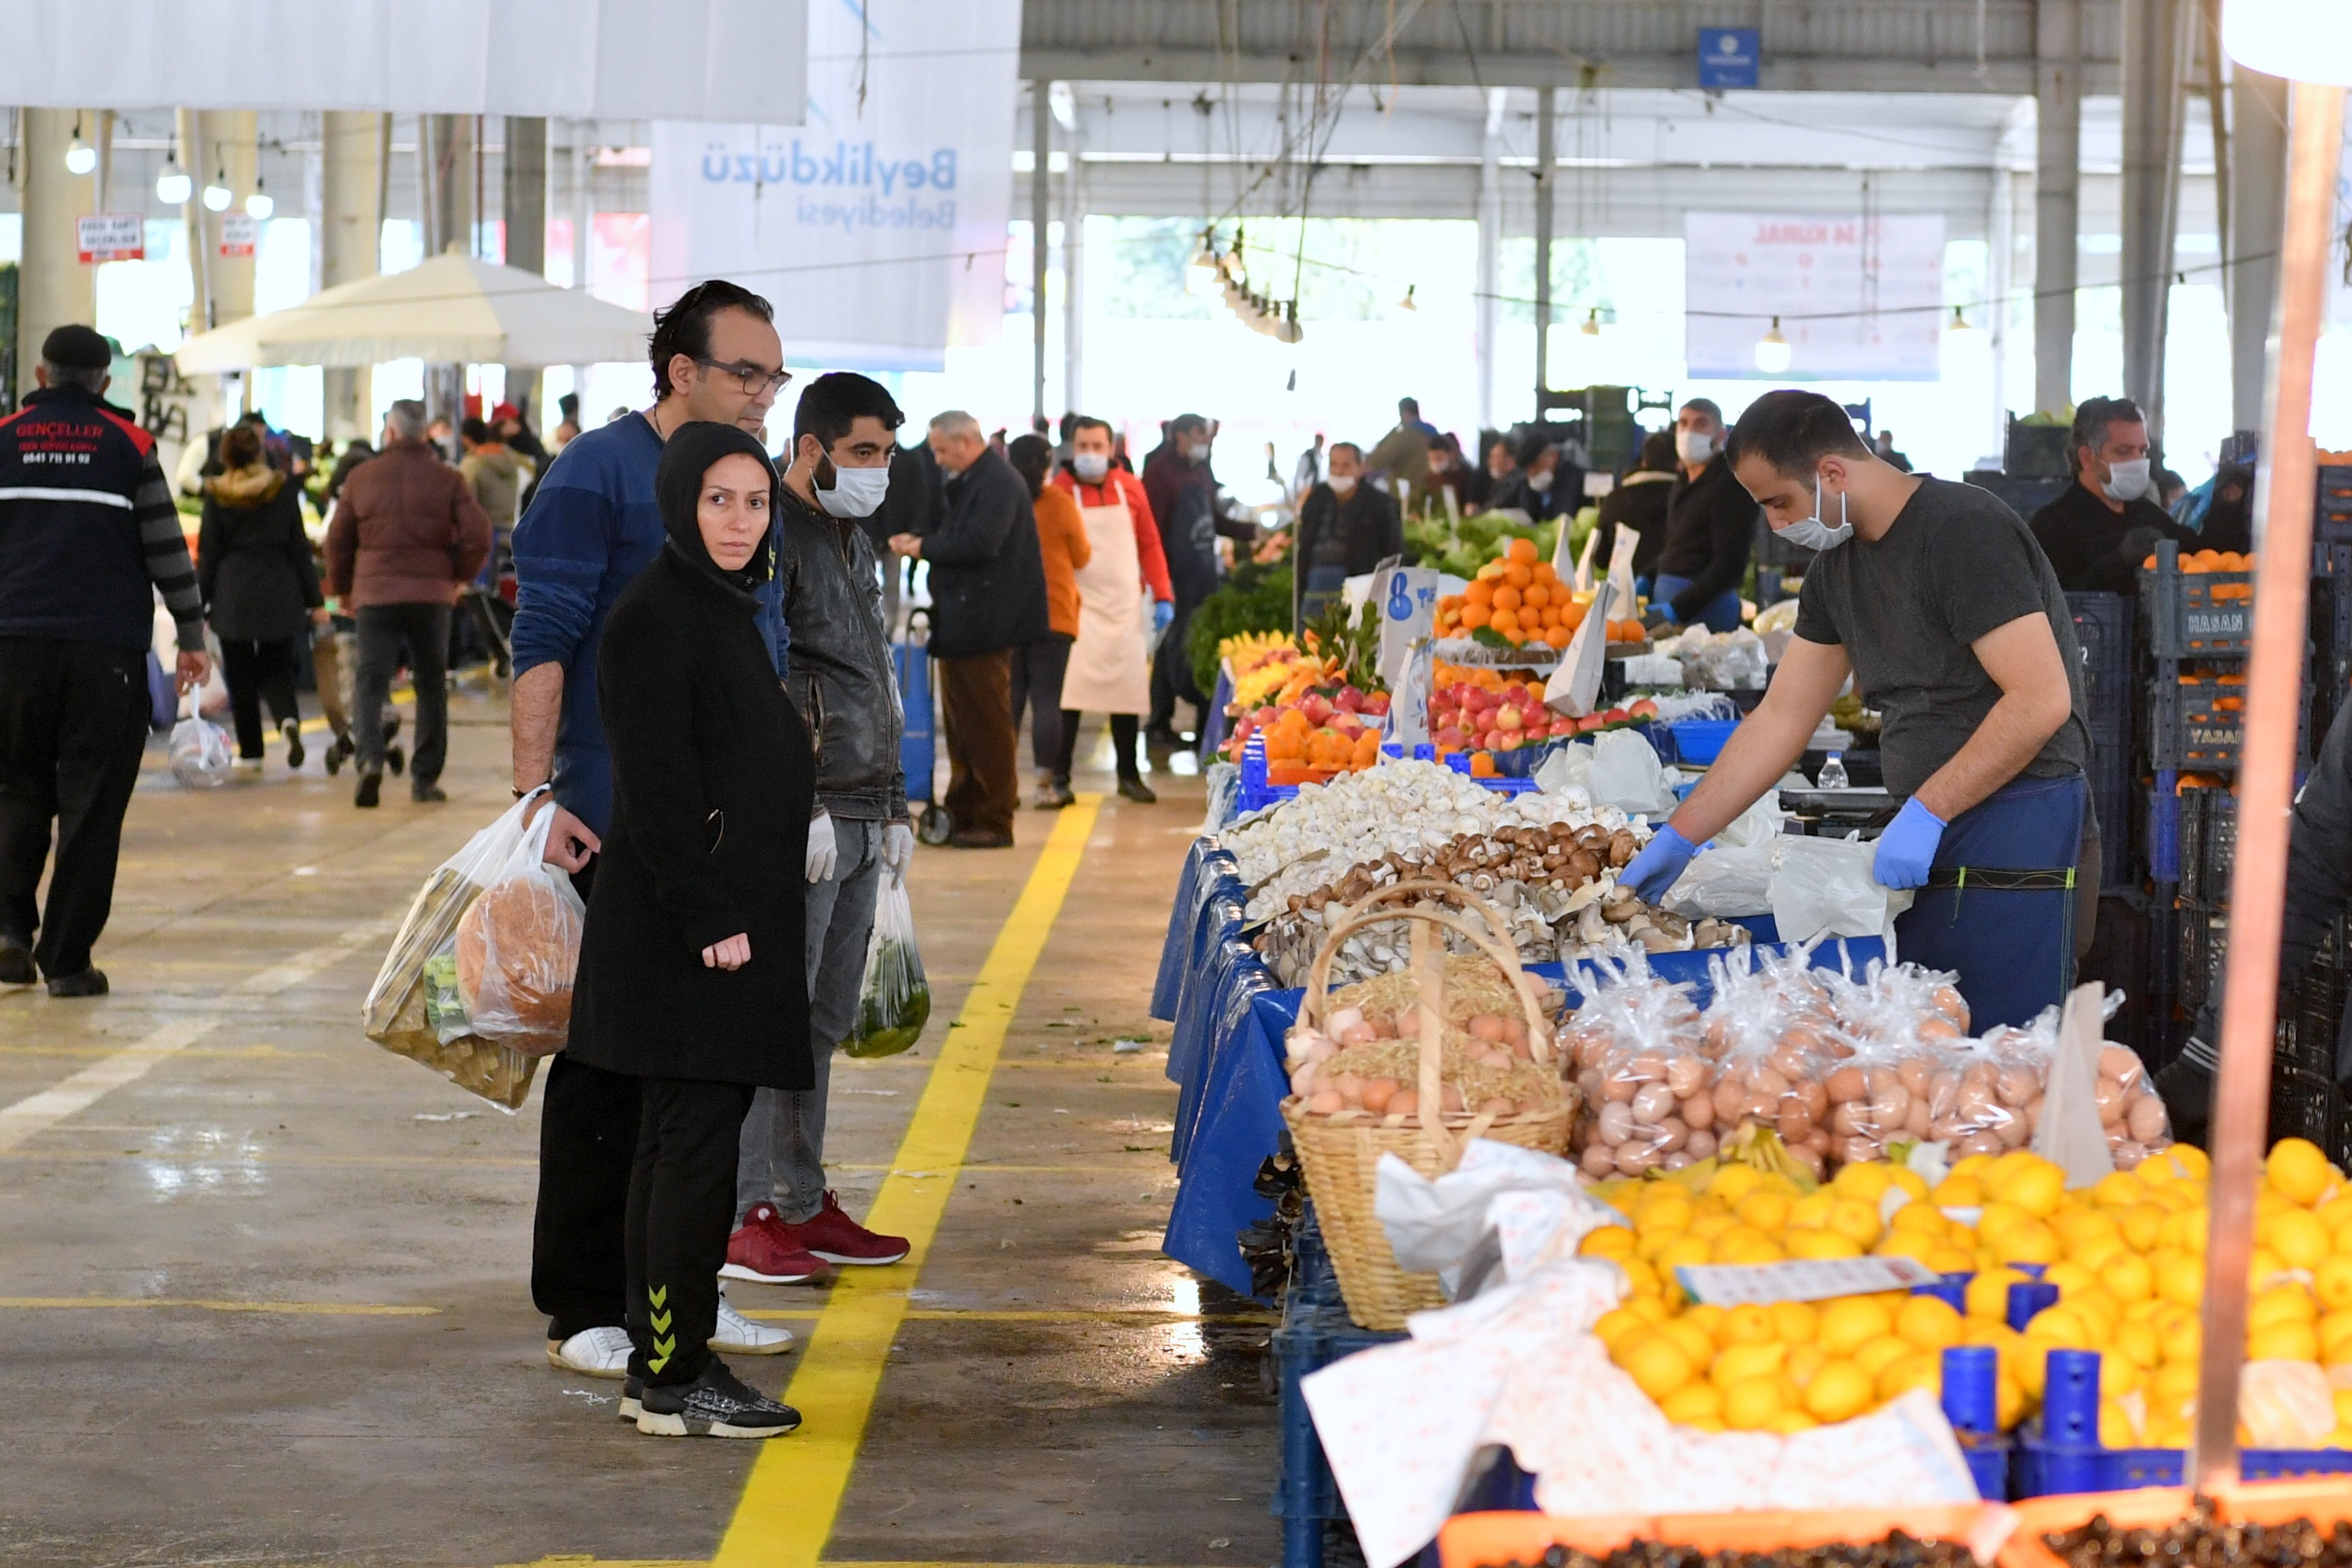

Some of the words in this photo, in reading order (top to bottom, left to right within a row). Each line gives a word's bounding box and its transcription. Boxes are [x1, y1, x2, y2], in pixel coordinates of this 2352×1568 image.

[16, 422, 103, 441] GENÇELLER
[1388, 572, 1413, 621] 8
[2187, 614, 2244, 633] HASAN
